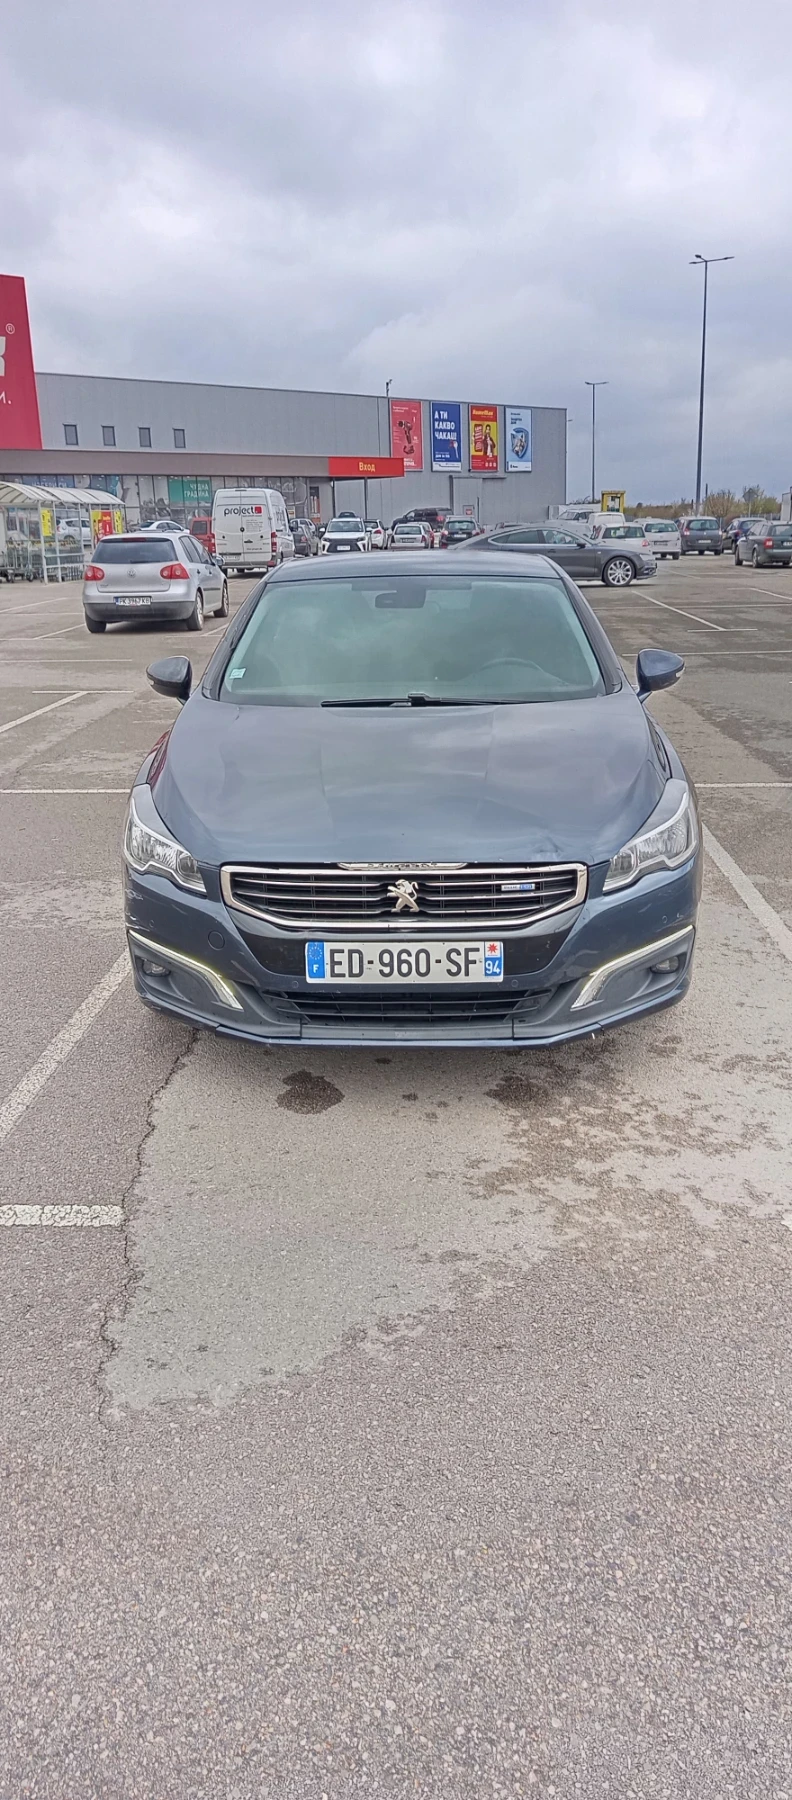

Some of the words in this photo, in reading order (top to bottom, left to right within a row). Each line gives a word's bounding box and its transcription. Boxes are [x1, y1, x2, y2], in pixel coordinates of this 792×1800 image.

[434, 421, 455, 430] КАКВО
[358, 462, 376, 472] Вход
[223, 506, 254, 516] project
[329, 947, 480, 978] ED-960-SF
[485, 960, 500, 974] 94
[313, 964, 319, 973] F
